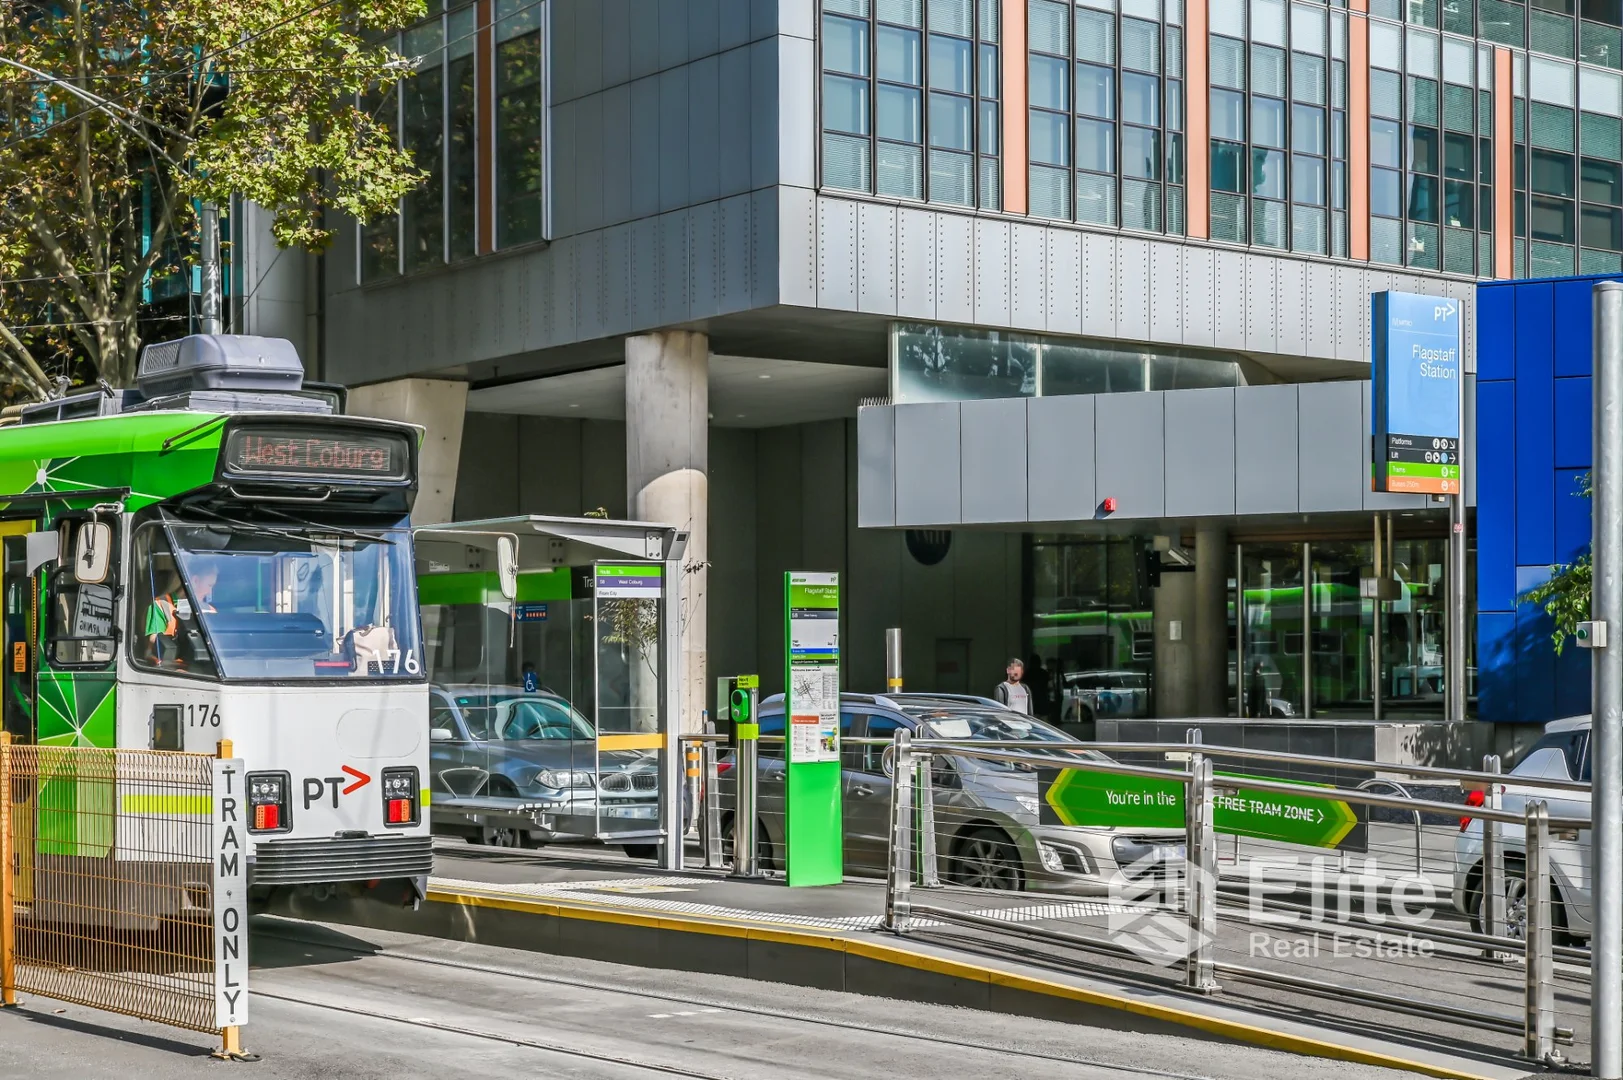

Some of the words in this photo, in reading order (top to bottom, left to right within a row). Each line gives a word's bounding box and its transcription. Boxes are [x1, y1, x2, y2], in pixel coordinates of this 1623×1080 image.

[1412, 344, 1456, 363] Flagstaff
[1420, 362, 1456, 379] Station
[245, 436, 299, 466] West
[305, 439, 385, 470] Coburg
[1391, 437, 1413, 446] Platforms
[1391, 451, 1399, 459] Lift
[372, 649, 421, 675] 176
[187, 703, 221, 728] 176
[1105, 789, 1141, 806] You're
[1143, 789, 1154, 806] in
[1157, 790, 1176, 806] the
[1218, 795, 1247, 813] FREE
[1248, 800, 1282, 817] TRAM
[1284, 804, 1315, 822] ZONE
[221, 769, 240, 878] TRAM
[222, 907, 242, 1015] ONLY
